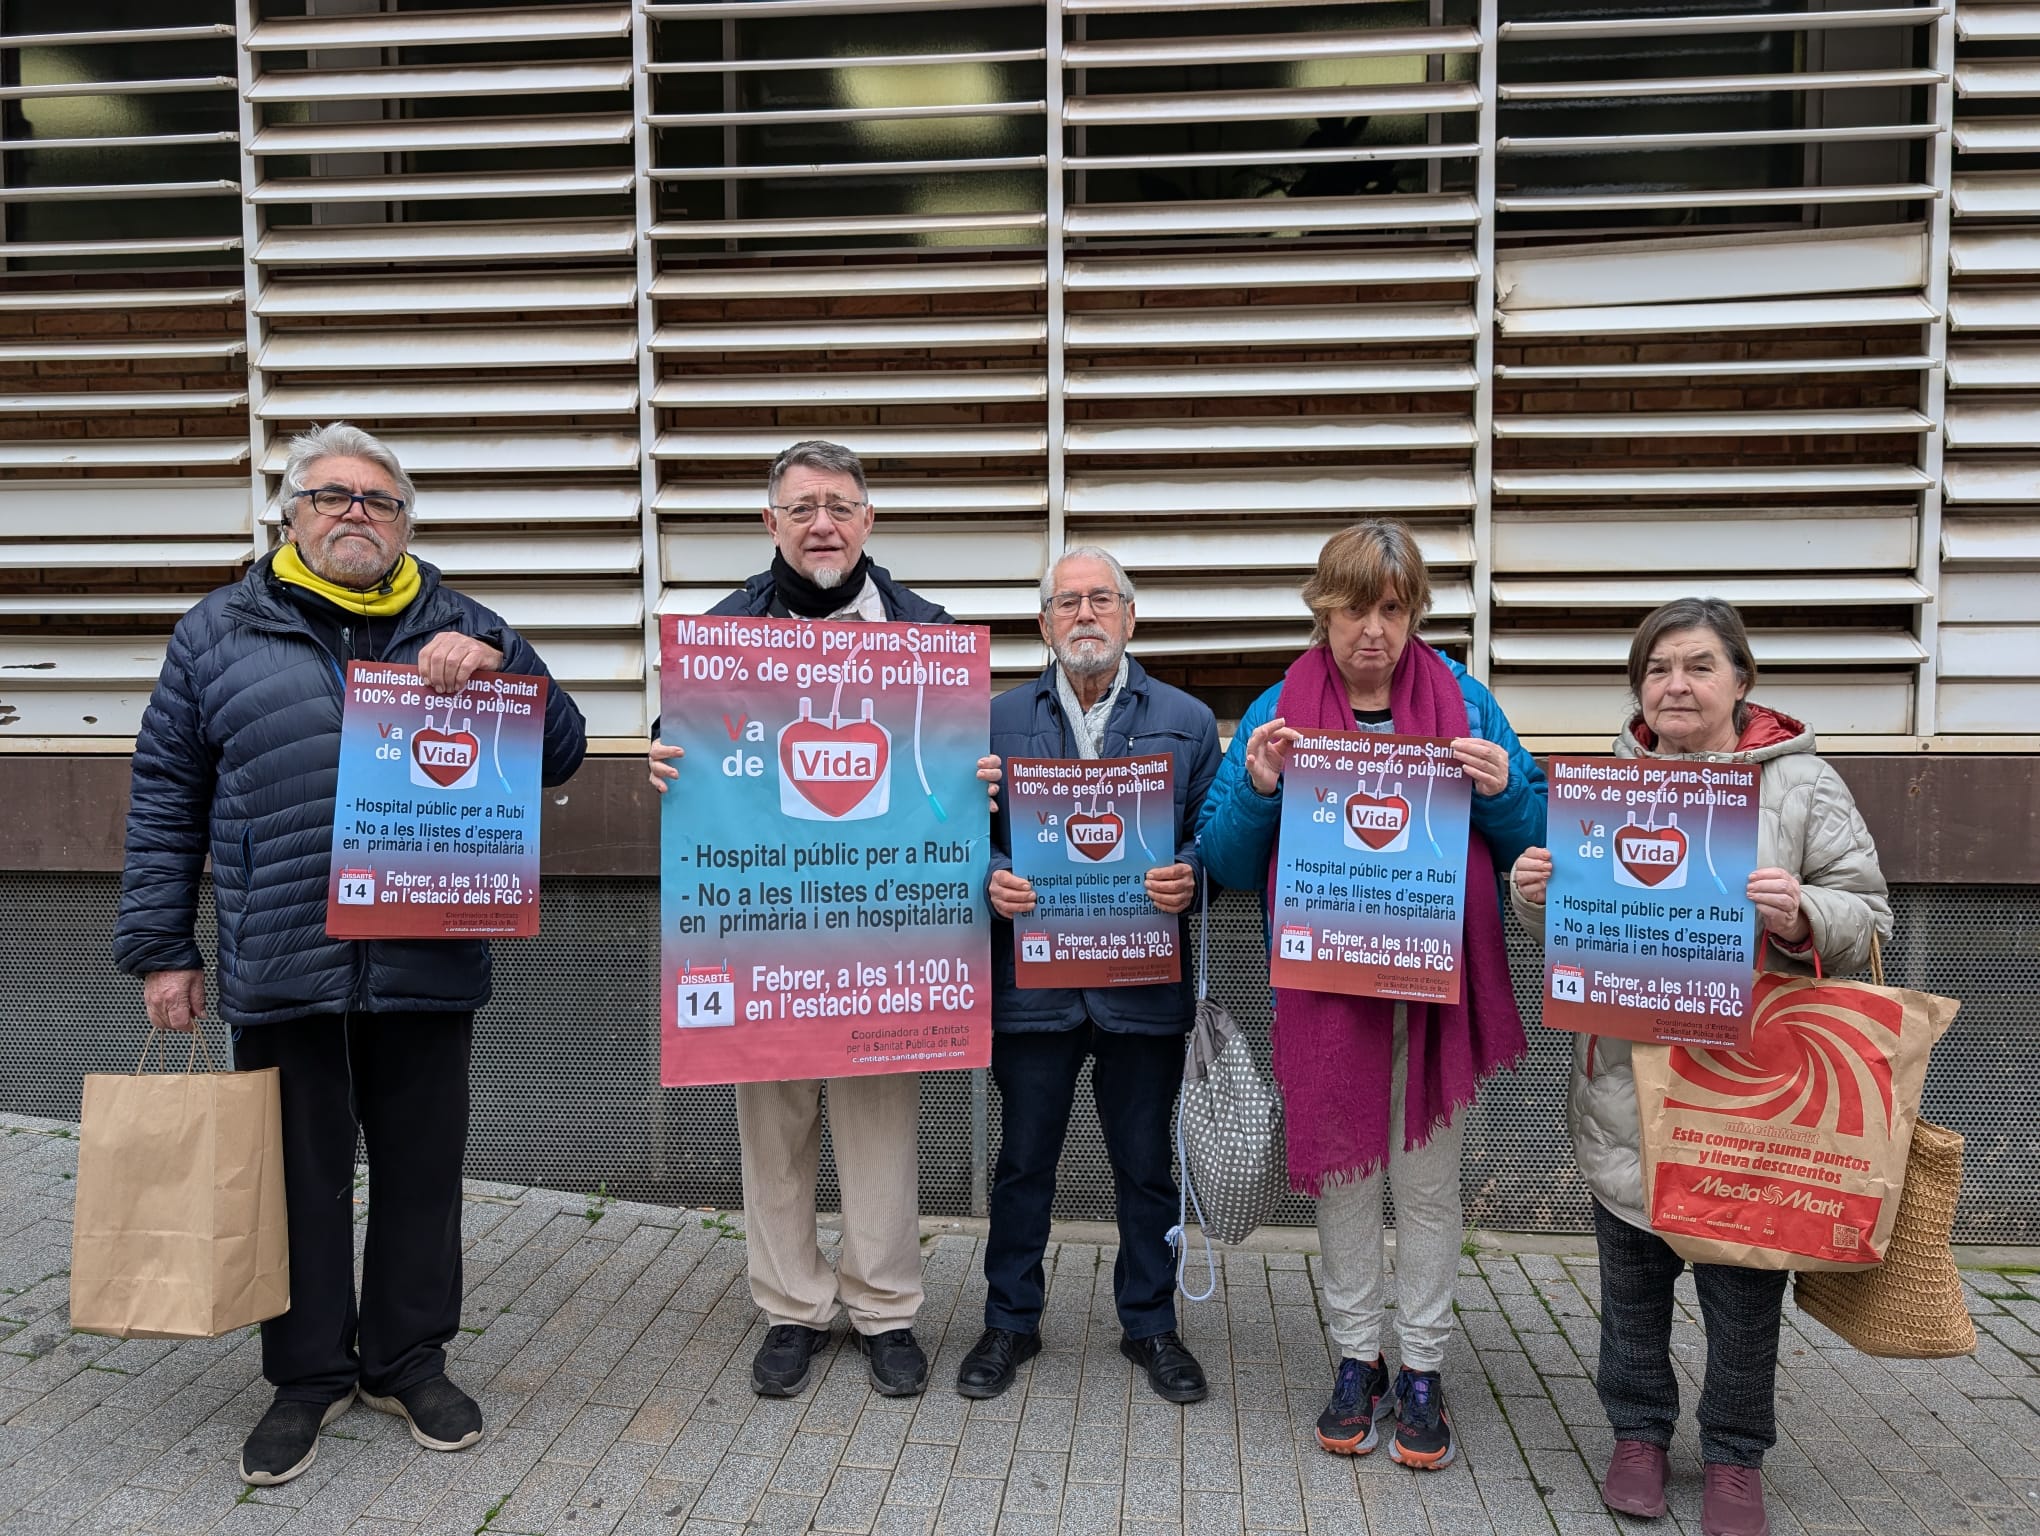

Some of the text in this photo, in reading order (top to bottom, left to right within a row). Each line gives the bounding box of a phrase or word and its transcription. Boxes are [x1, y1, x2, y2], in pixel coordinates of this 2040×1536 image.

[678, 620, 976, 655] Manifestació per una Sanitat
[680, 656, 969, 690] 100% de gestió pública
[468, 680, 490, 692] una
[494, 678, 538, 696] Sanitat
[354, 688, 531, 715] 100% de gestió pública
[378, 723, 403, 740] Va
[723, 714, 764, 742] Va
[376, 744, 401, 760] de
[424, 746, 468, 764] Vida
[722, 750, 764, 777] de
[798, 750, 871, 777] Vida
[1014, 760, 1167, 779] Manifestació per una Sanitat
[1293, 754, 1462, 779] 100% de gestió pública
[1555, 763, 1753, 786] Manifestació per una Sanitat
[1015, 779, 1164, 798] 100% de gestió pública
[1315, 787, 1337, 804] Va
[1556, 784, 1747, 808] 100% de gestió pública
[356, 799, 524, 818] Hospital públic per a Rubí
[1037, 811, 1058, 825] Va
[1312, 807, 1336, 823] de
[1356, 810, 1398, 828] Vida
[1038, 829, 1058, 843] de
[1075, 828, 1114, 842] Vida
[1580, 820, 1604, 838] Va
[696, 840, 970, 873] Hospital públic per a Rubí
[1579, 842, 1604, 858] de
[1626, 844, 1674, 863] Vida
[386, 871, 519, 888] Febrer, a les 11:00 h
[381, 891, 398, 902] en
[464, 890, 490, 904] dels
[494, 890, 522, 904] FGC
[699, 883, 730, 906] No
[739, 888, 750, 904] a
[760, 882, 792, 903] les
[801, 881, 867, 904] llistes
[1296, 880, 1313, 894] No
[1317, 885, 1324, 895] a
[1329, 883, 1348, 897] les
[1352, 884, 1391, 900] llistes
[1284, 896, 1299, 907] en
[1306, 898, 1355, 913] primària
[1366, 903, 1380, 914] en
[1385, 902, 1456, 921] hospitalària
[1564, 895, 1744, 922] Hospital públic per a Rubí
[680, 906, 973, 938] en primària i en hospitalària
[1058, 933, 1097, 947] Febrer,
[1101, 936, 1107, 945] a
[1111, 933, 1126, 945] les
[1130, 932, 1159, 945] 11:00
[1163, 931, 1169, 943] h
[1285, 940, 1305, 953] 14
[1322, 929, 1451, 954] Febrer, a les 11:00 h
[1026, 944, 1044, 957] 14
[1055, 950, 1069, 960] en
[1122, 945, 1145, 959] dels
[1149, 944, 1173, 957] FGC
[681, 973, 730, 984] DISSABTE
[753, 958, 968, 994] Febrer, a les 11:00 h
[1554, 968, 1582, 976] DISSABTE
[1556, 979, 1577, 994] 14
[686, 991, 722, 1016] 14
[746, 1001, 772, 1021] en
[879, 990, 922, 1014] dels
[930, 985, 974, 1011] FGC
[1591, 990, 1606, 1003] en
[1674, 996, 1705, 1014] dels
[1710, 1000, 1743, 1017] FGC
[852, 1025, 969, 1039] Coordinadora d'Entitats
[847, 1036, 969, 1054] per la Sanitat Pública de Rubí
[853, 1051, 965, 1063] c.entitats.sanitat@gmail.com
[1726, 1121, 1820, 1144] miMediaMarkt
[1672, 1127, 1871, 1172] Esta compra suma puntos
[1699, 1149, 1842, 1184] y lleva descuentos
[1691, 1175, 1846, 1218] Media Markt
[1678, 1214, 1696, 1223] tienda
[1707, 1220, 1751, 1231] mediamarkt.es
